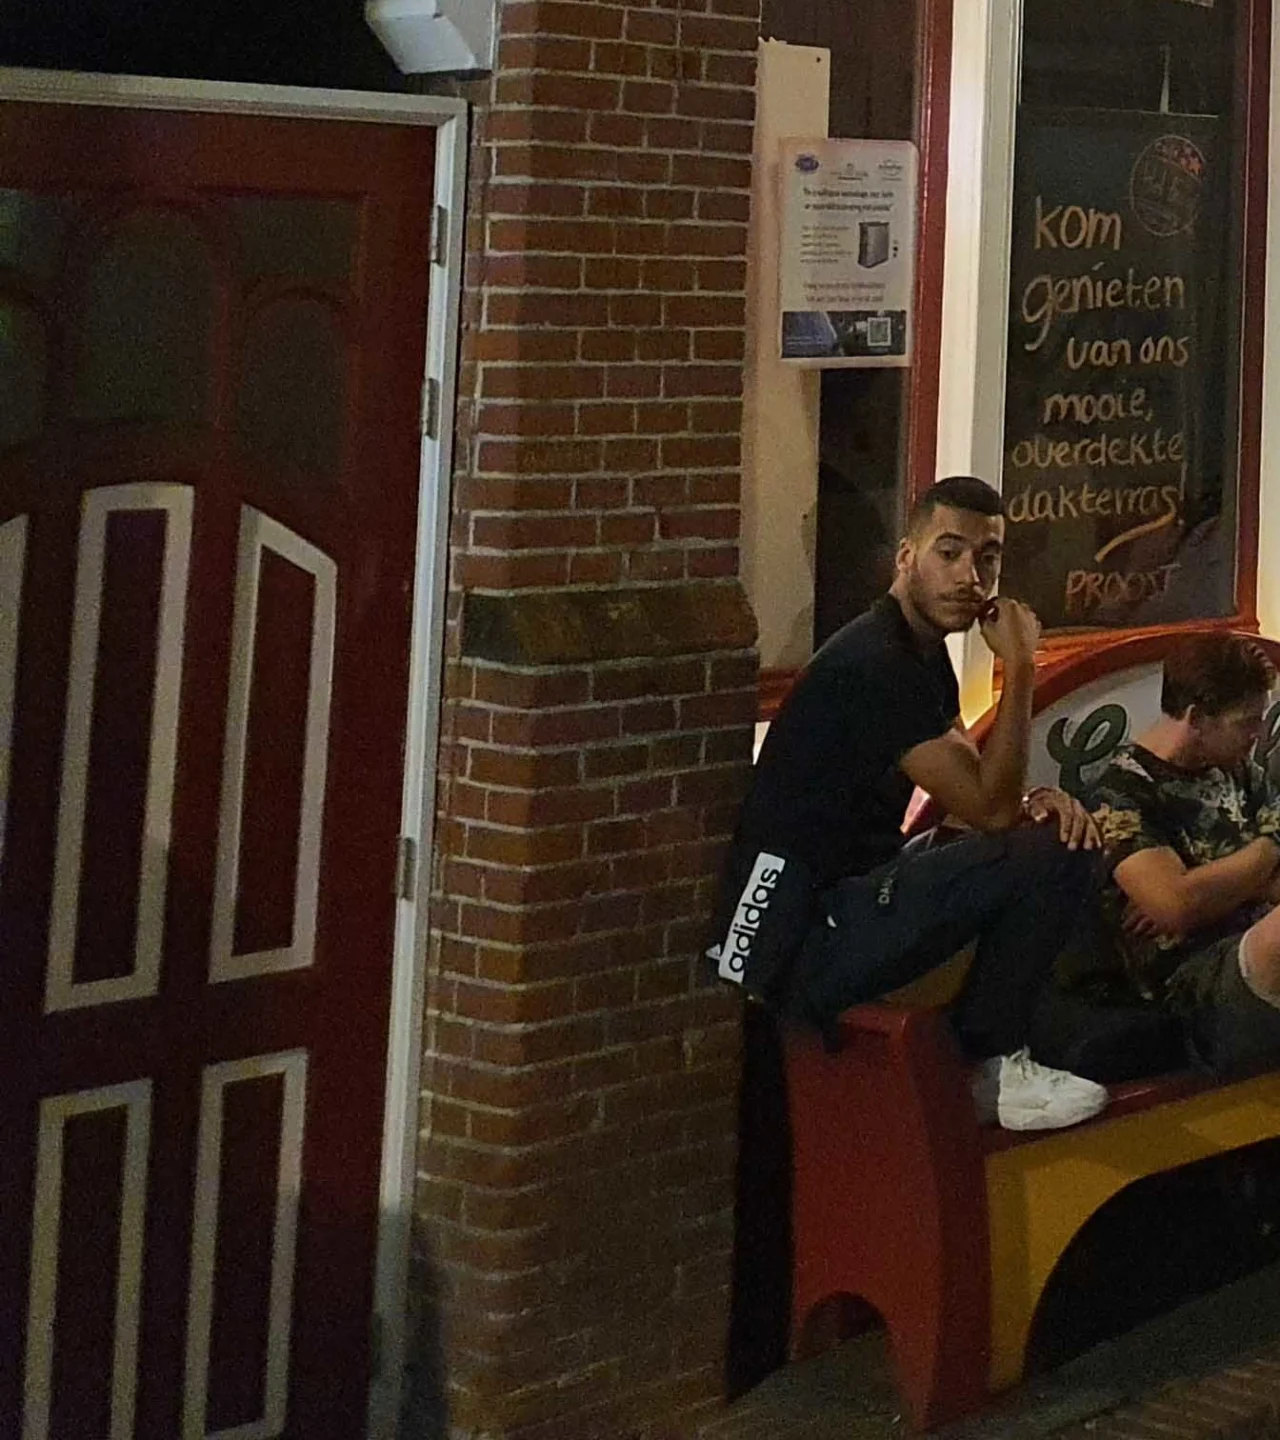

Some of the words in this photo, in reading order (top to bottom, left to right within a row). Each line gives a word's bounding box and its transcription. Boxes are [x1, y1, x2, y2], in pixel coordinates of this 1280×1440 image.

[1032, 194, 1123, 252] kom
[1020, 260, 1186, 352] genieten
[1065, 335, 1132, 372] van
[1138, 333, 1190, 369] ons
[1010, 429, 1184, 469] overdekte
[1064, 562, 1183, 612] PROOST
[728, 866, 782, 974] adidas
